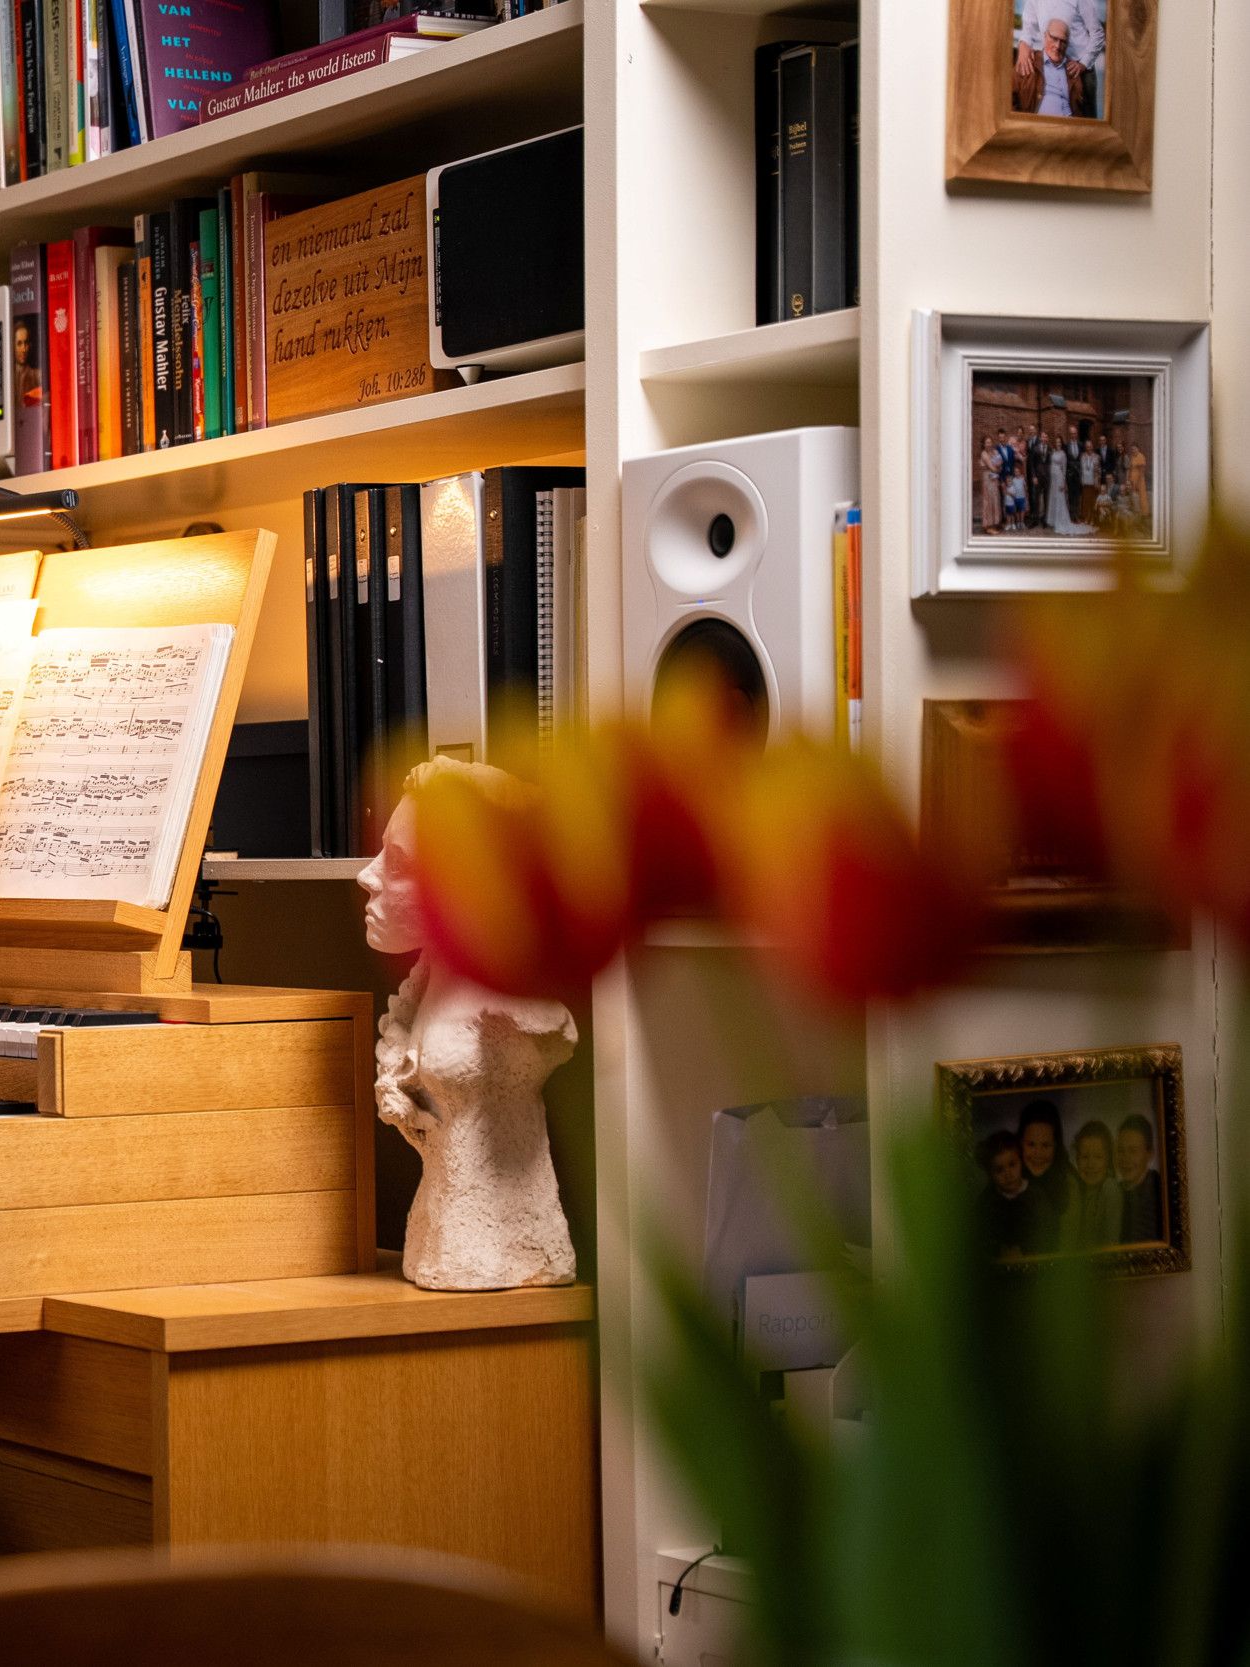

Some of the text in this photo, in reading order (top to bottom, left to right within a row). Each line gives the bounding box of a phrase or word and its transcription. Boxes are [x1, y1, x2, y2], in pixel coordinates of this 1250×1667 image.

[52, 0, 60, 30] ESIS
[158, 4, 191, 16] VAN
[25, 40, 33, 57] Day
[161, 36, 190, 48] HET
[119, 45, 130, 86] Verlangen
[164, 67, 232, 82] HELLEND
[208, 97, 242, 116] Gustav
[244, 80, 284, 104] Mahler:
[288, 70, 305, 88] the
[308, 56, 340, 82] world
[341, 49, 376, 71] listens
[168, 99, 201, 111] VLA
[788, 121, 807, 136] Bijbel
[248, 212, 256, 263] Tamminga
[272, 192, 413, 267] en niemand zal
[49, 270, 69, 282] BACH
[273, 248, 423, 315] dezelve uit Mijn
[182, 294, 190, 324] Felix
[153, 287, 169, 390] Gustav Mahler
[173, 289, 183, 390] Mendelssohn
[273, 308, 390, 364] hand rukken.
[78, 351, 86, 385] BACH
[358, 374, 381, 402] Joh.
